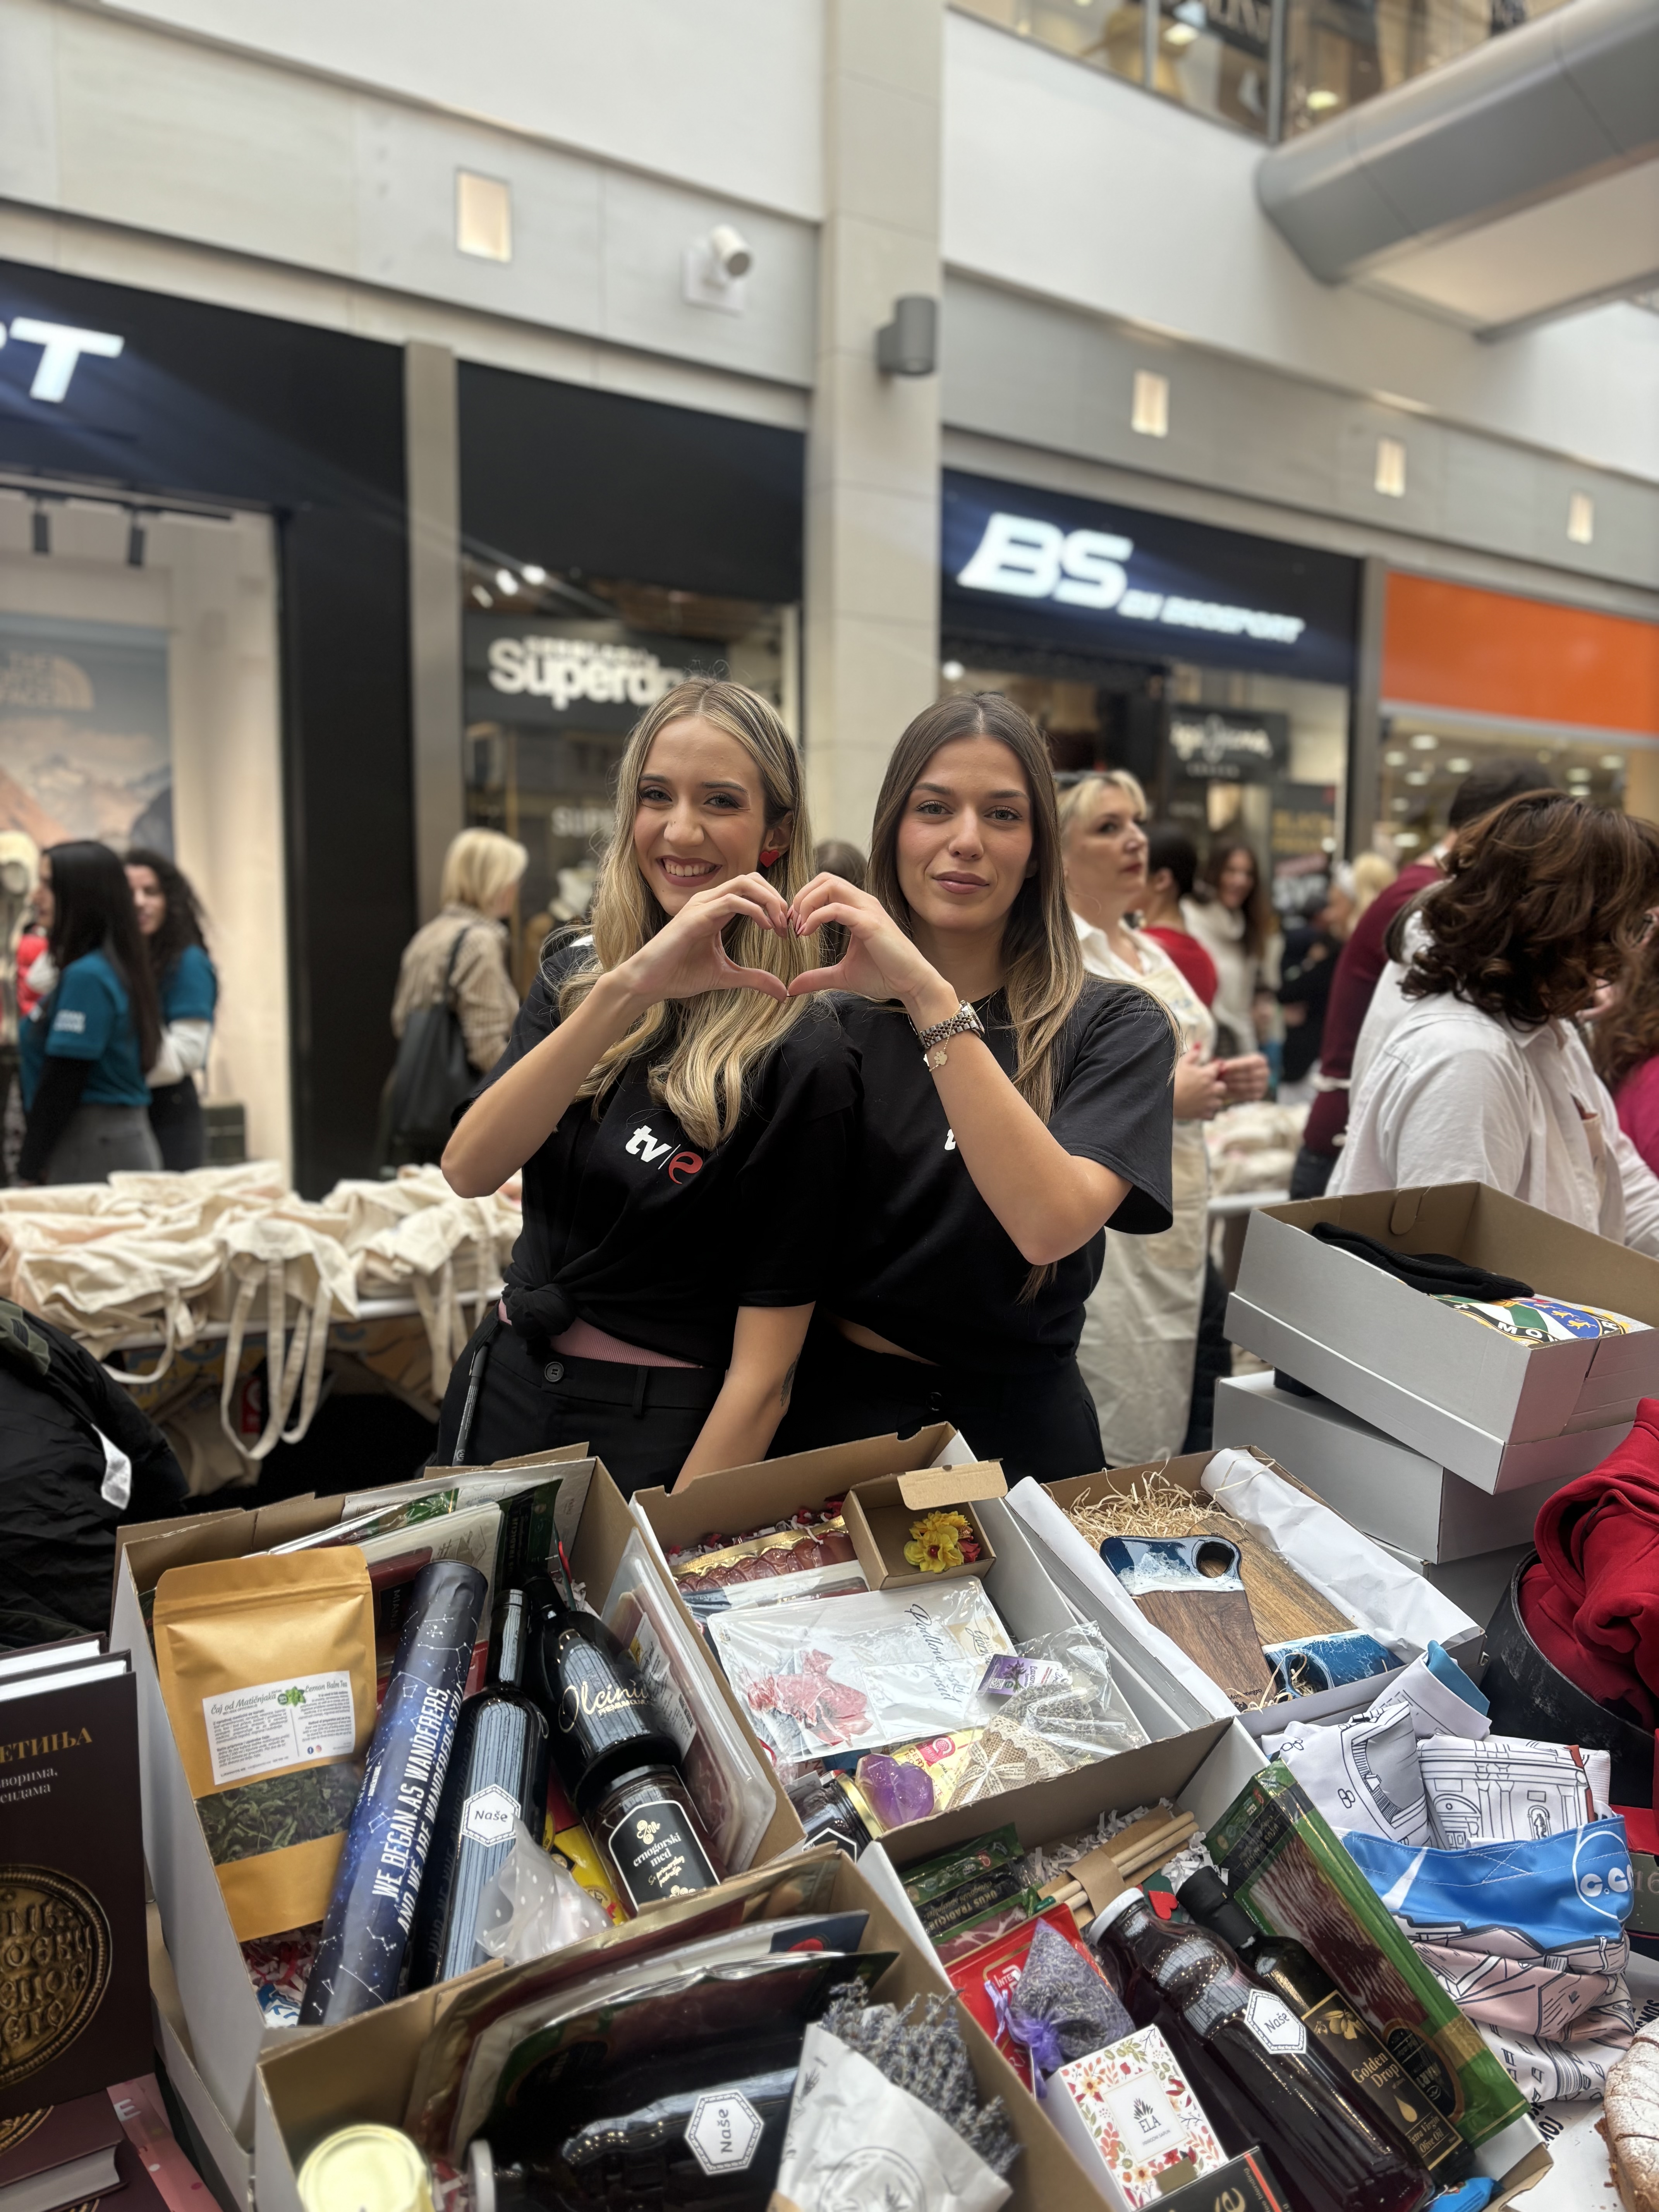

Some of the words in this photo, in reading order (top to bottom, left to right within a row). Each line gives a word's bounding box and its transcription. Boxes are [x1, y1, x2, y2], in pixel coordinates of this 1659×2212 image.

[957, 512, 1133, 609] BS
[305, 1683, 325, 1693] Lemon
[326, 1680, 339, 1689] Balm
[211, 1704, 223, 1716] Čaj
[224, 1700, 234, 1711] od
[424, 1722, 455, 1824] WANDERERS
[398, 1783, 425, 1813] AS
[474, 1809, 508, 1823] Naše
[381, 1809, 418, 1870] BEGAN
[415, 1820, 433, 1861] ARE
[633, 1832, 682, 1867] crnogorski
[372, 1869, 403, 1899] WE
[407, 1860, 424, 1891] WE
[397, 1890, 416, 1936] AND
[1264, 2011, 1291, 2033] Naše
[1351, 2052, 1388, 2083] Golden
[1370, 2064, 1400, 2088] Drop
[717, 2108, 733, 2154] Naše
[1138, 2115, 1161, 2133] ELA
[1421, 2115, 1440, 2133] Virgin
[1419, 2138, 1435, 2153] Olive
[1433, 2128, 1444, 2142] Oil
[1243, 2167, 1263, 2200] blending
